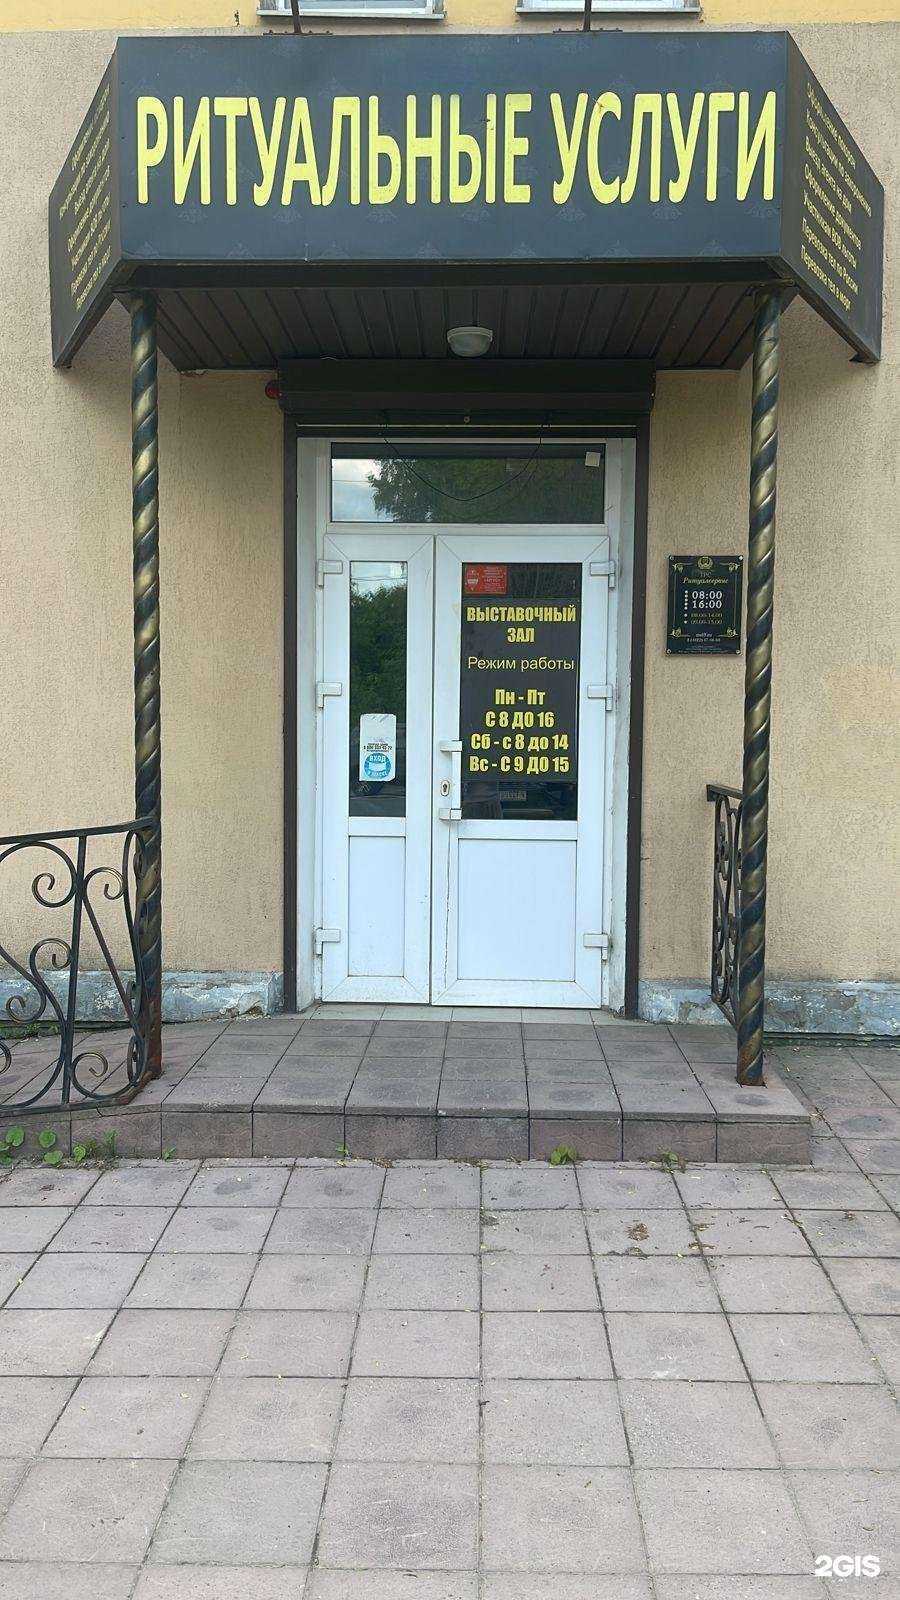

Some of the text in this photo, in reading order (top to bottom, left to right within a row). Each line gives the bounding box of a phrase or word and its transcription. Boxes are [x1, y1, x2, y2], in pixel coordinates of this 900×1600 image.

[137, 94, 531, 207] РИТУАЛЬНЫЕ
[550, 91, 776, 204] УСЛУГИ
[692, 590, 722, 600] 08:00
[692, 600, 722, 608] 16:00
[467, 605, 576, 622] ВЫСТАВОЧНЫЙ
[507, 628, 535, 643] ЗАЛ
[468, 657, 574, 672] Режим работы
[495, 690, 515, 705] Пн
[527, 690, 545, 705] Пт
[486, 712, 554, 729] С 8 ДО 16
[471, 734, 490, 749] Сб
[515, 734, 525, 749] 8
[528, 738, 549, 751] до
[552, 734, 568, 750] 14
[470, 757, 488, 772] Вс
[514, 757, 524, 772] 9
[527, 757, 549, 774] ДО
[552, 757, 569, 772] 15
